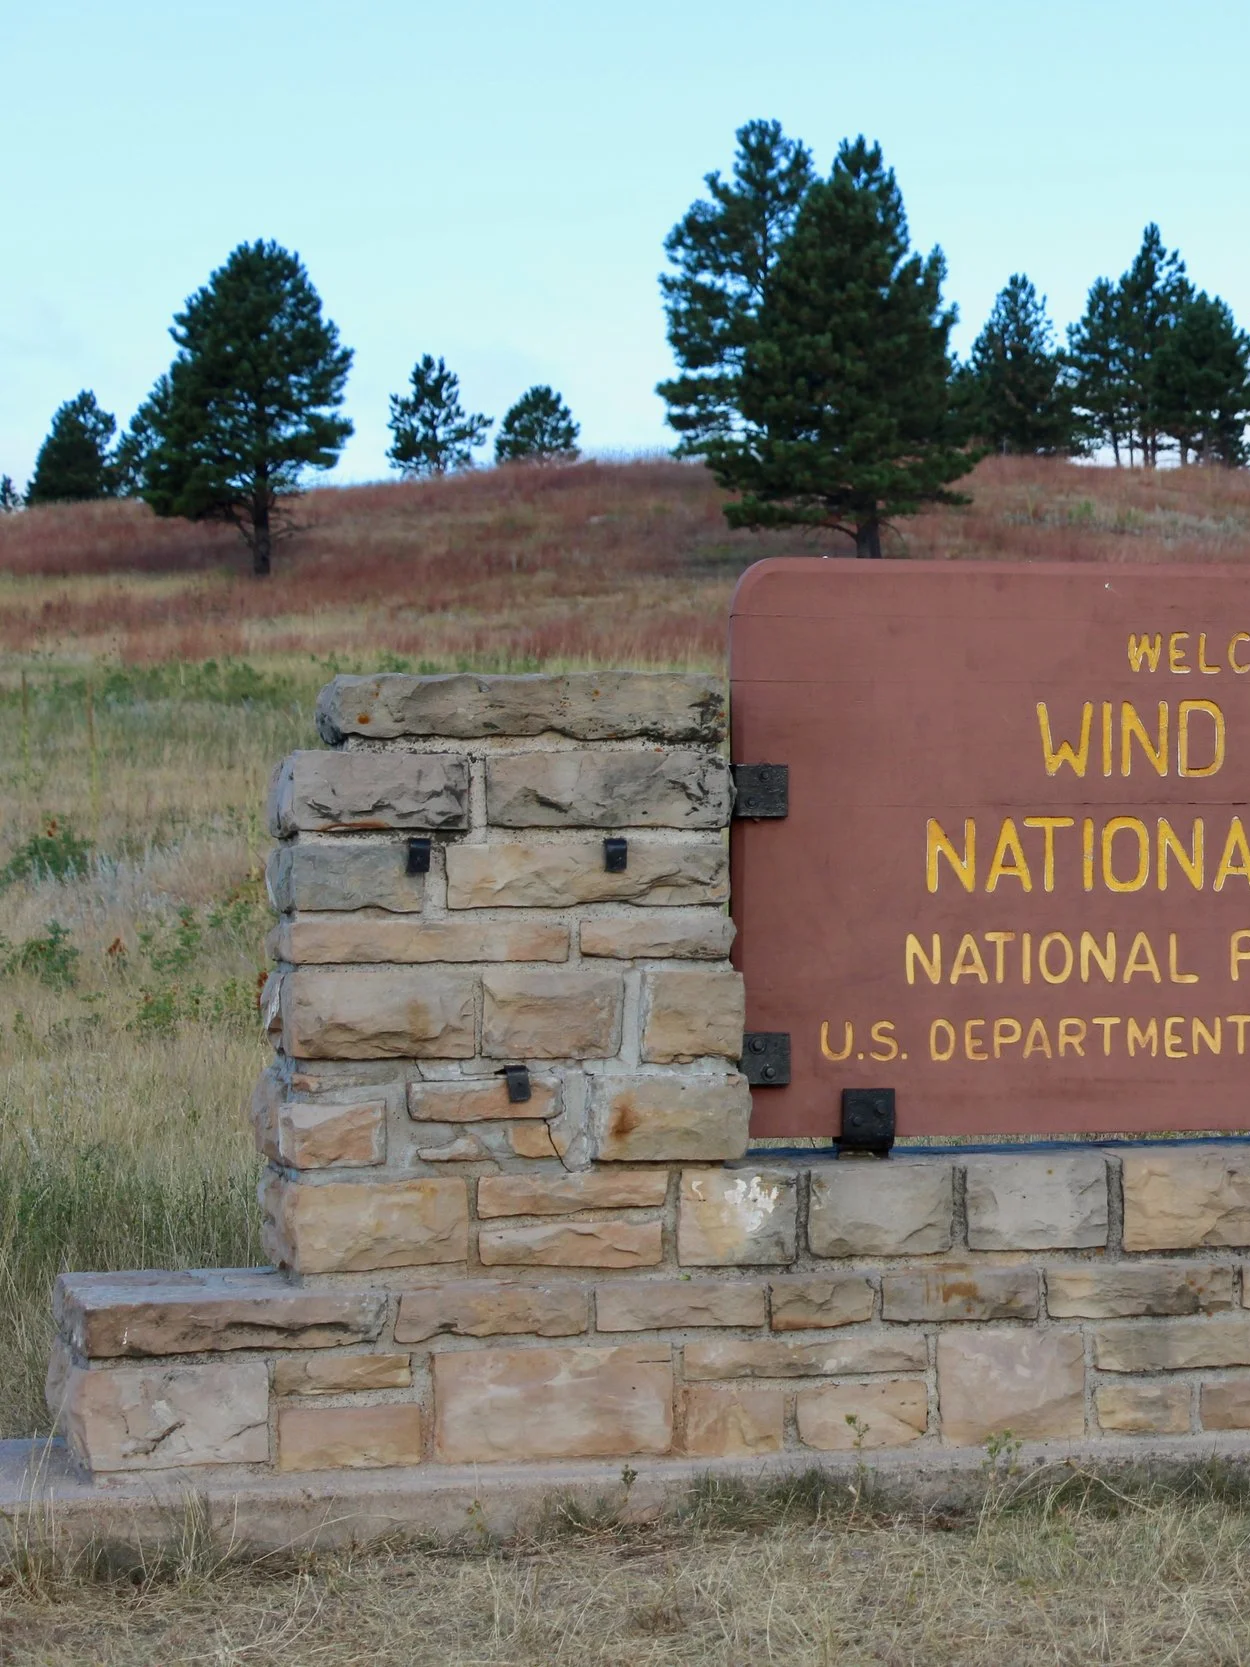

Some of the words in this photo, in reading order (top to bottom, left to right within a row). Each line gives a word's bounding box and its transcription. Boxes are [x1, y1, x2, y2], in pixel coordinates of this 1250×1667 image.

[1036, 698, 1226, 777] WIND
[905, 931, 1200, 985] NATIONAL
[820, 1020, 909, 1061] U.S.
